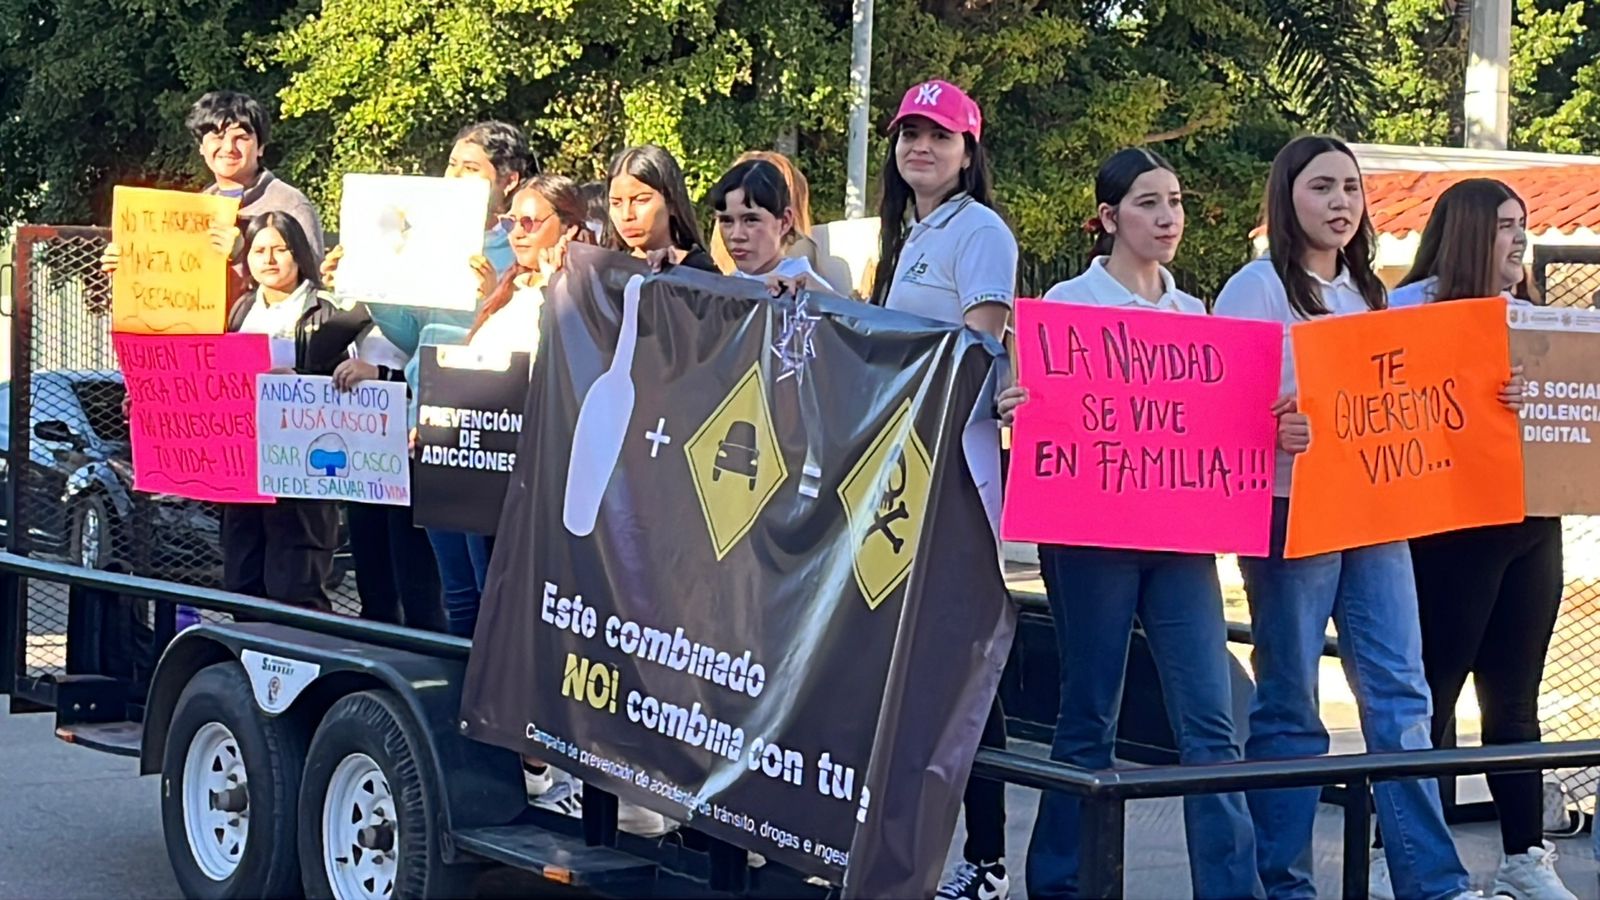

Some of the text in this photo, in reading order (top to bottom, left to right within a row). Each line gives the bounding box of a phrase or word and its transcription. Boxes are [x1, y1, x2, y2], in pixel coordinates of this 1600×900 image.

[189, 343, 216, 370] TE
[1038, 321, 1224, 385] LA NAVIDAD
[1371, 349, 1406, 388] TE
[174, 372, 199, 403] EN
[206, 372, 255, 401] CASA
[261, 378, 389, 411] ANDÁS EN MOTO
[419, 404, 522, 433] PREVENCIÓN
[1081, 393, 1187, 434] SE VIVE
[1335, 378, 1464, 441] QUEREMOS
[1519, 403, 1600, 422] VIOLENCI
[459, 429, 480, 449] DE
[1523, 425, 1591, 444] DIGITAL
[261, 444, 402, 475] USAR CASCO
[421, 445, 517, 472] ADICCIONES
[1035, 441, 1077, 477] EN
[262, 474, 312, 496] PUEDE
[317, 478, 366, 499] SALVAR
[368, 477, 384, 500] TÚ
[541, 581, 766, 698] Este combinado
[561, 653, 855, 801] NO! combina con tu
[580, 750, 634, 780] prevención
[635, 770, 649, 788] de
[760, 821, 800, 848] drogas
[803, 840, 812, 853] e
